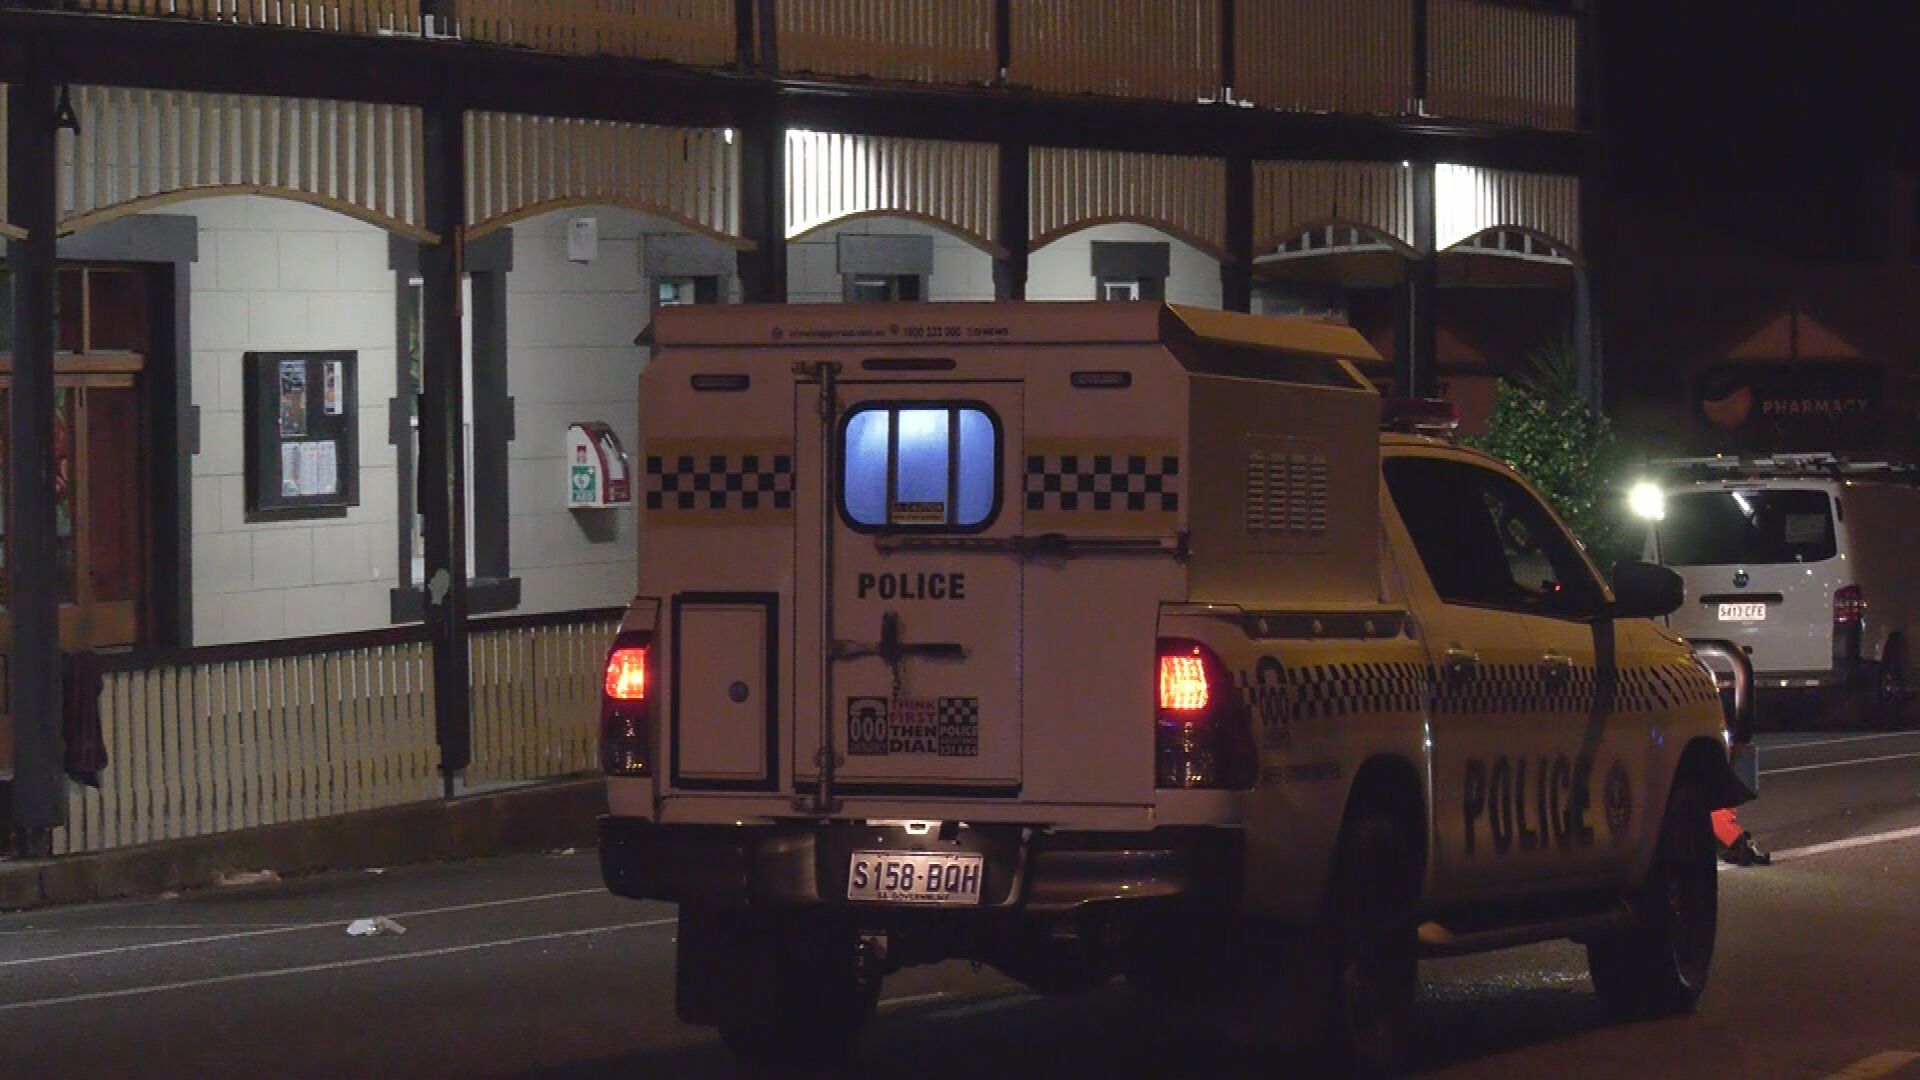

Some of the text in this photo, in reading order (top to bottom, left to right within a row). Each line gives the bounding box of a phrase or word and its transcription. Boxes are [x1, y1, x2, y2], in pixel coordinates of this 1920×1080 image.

[1761, 399, 1868, 415] PHARMACY
[857, 573, 965, 600] POLICE
[890, 699, 937, 711] THINK
[890, 711, 937, 723] FIRST
[850, 717, 887, 741] 000
[889, 725, 938, 737] THEN
[939, 725, 977, 736] POLICE
[889, 739, 938, 753] DIAL
[1463, 755, 1595, 857] POLICE
